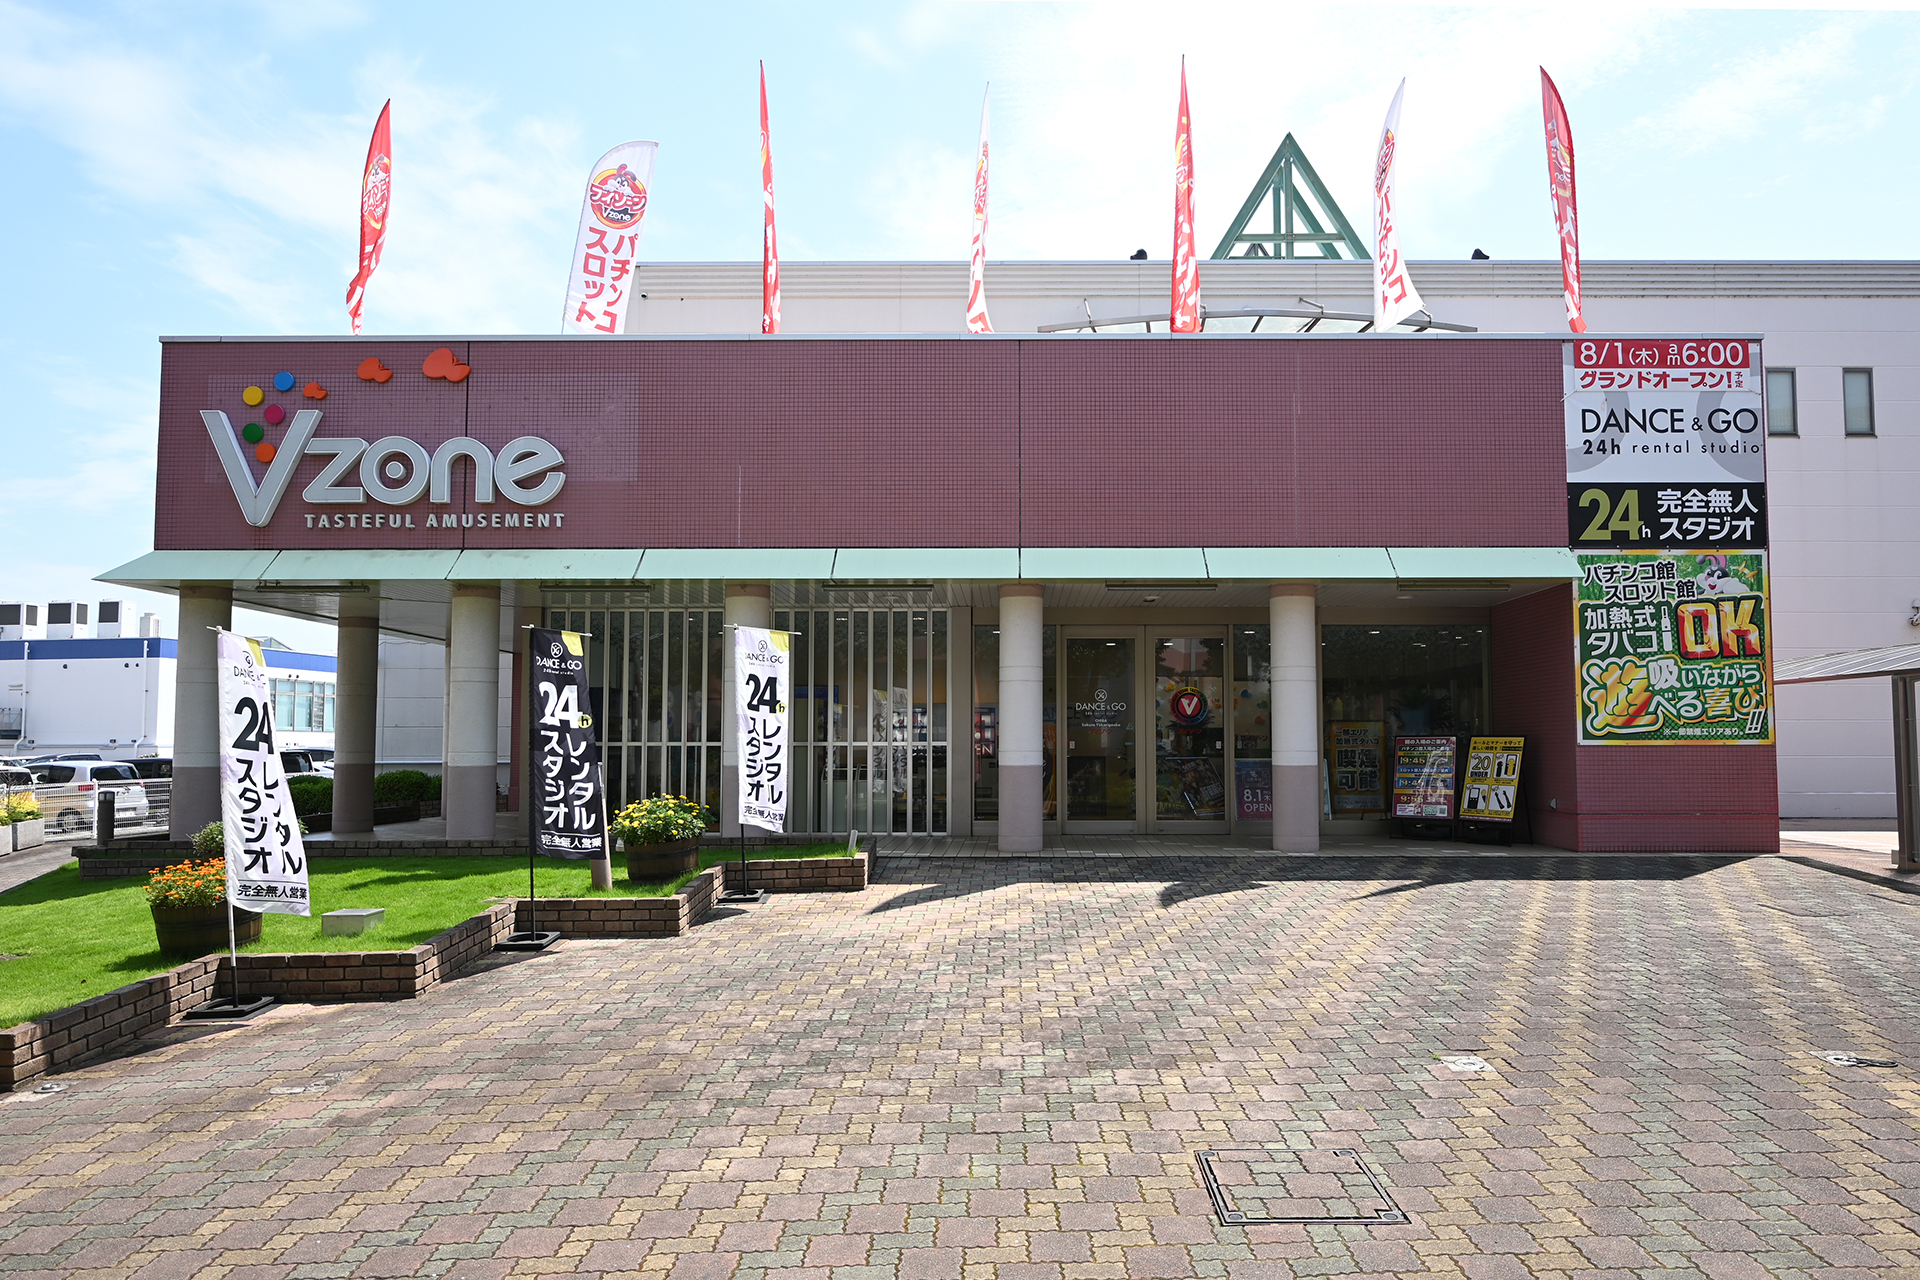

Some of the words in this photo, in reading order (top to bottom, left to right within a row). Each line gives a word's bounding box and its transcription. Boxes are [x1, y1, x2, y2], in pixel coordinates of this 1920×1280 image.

[576, 226, 610, 323] スロット
[594, 233, 639, 334] パチンコ
[1581, 408, 1685, 434] DANCE
[1691, 416, 1703, 432] &
[1707, 408, 1759, 434] GO
[1582, 438, 1621, 455] 24h
[1632, 439, 1690, 455] rental
[1701, 439, 1760, 455] studio
[1656, 488, 1759, 514] 完全無人
[304, 513, 416, 529] TASTEFUL
[425, 513, 565, 529] AMUSEMENT
[1659, 516, 1755, 541] スタジオ
[1584, 561, 1676, 585] パチンコ館
[1604, 579, 1696, 602] スロット館
[1584, 604, 1657, 631] 加熱式
[1676, 598, 1763, 660] OK
[1587, 630, 1658, 656] タバコ
[536, 655, 560, 669] DANCE
[567, 660, 583, 670] GO
[745, 652, 766, 663] ANCE
[1649, 658, 1762, 690] 吸いながら
[1075, 702, 1106, 711] DANCE
[1111, 702, 1127, 711] GO
[746, 716, 764, 802] スタジオ
[762, 719, 783, 805] レンタル
[1402, 756, 1426, 764] 9:45
[1471, 755, 1492, 771] 20
[541, 730, 569, 829] スタジオ
[566, 733, 596, 831] レンタル
[1337, 769, 1381, 791] 可能
[1470, 770, 1489, 778] UNDER
[1243, 788, 1262, 802] 8.1
[236, 757, 273, 874] スタジオ
[262, 761, 303, 875] レンタル
[1244, 803, 1273, 812] OPEN
[541, 834, 602, 849] 完全無人営業
[238, 884, 308, 901] 完全無人営業
